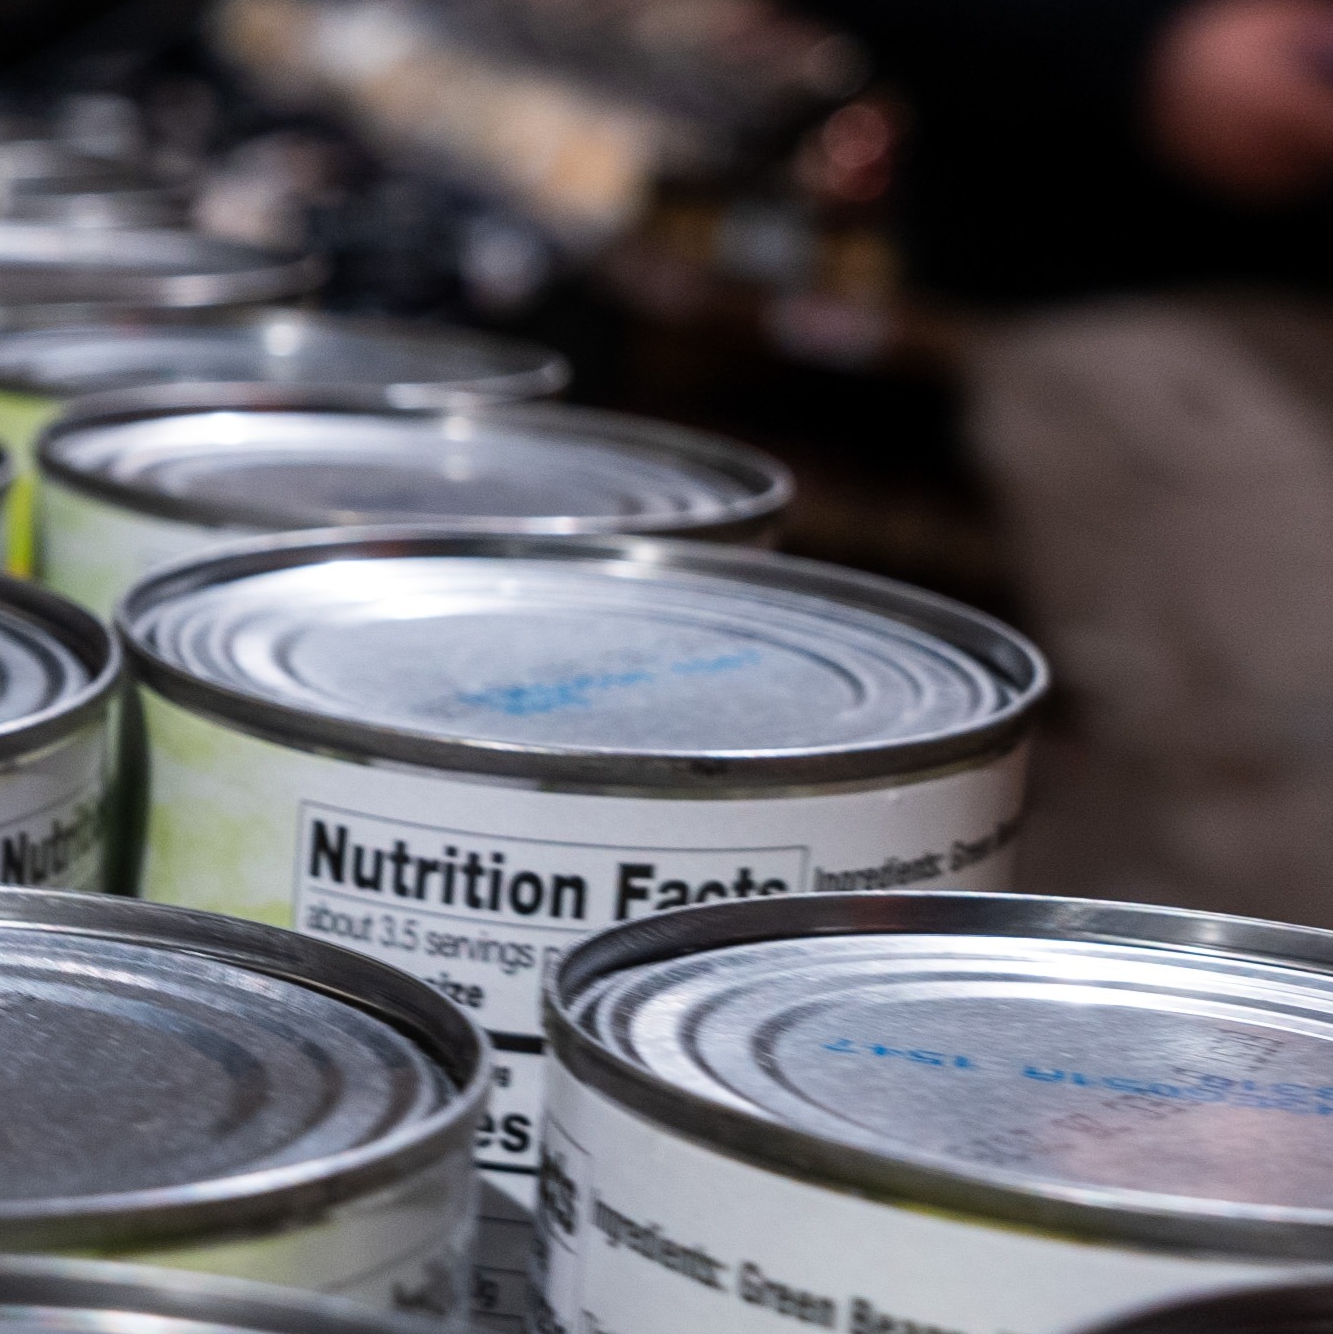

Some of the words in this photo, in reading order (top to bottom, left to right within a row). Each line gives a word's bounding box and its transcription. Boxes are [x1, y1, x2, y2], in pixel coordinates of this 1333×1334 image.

[310, 819, 586, 920] Nutrition
[306, 903, 373, 942] about
[379, 913, 418, 951] 3.5
[424, 928, 537, 976] servings
[738, 1260, 839, 1331] Green
